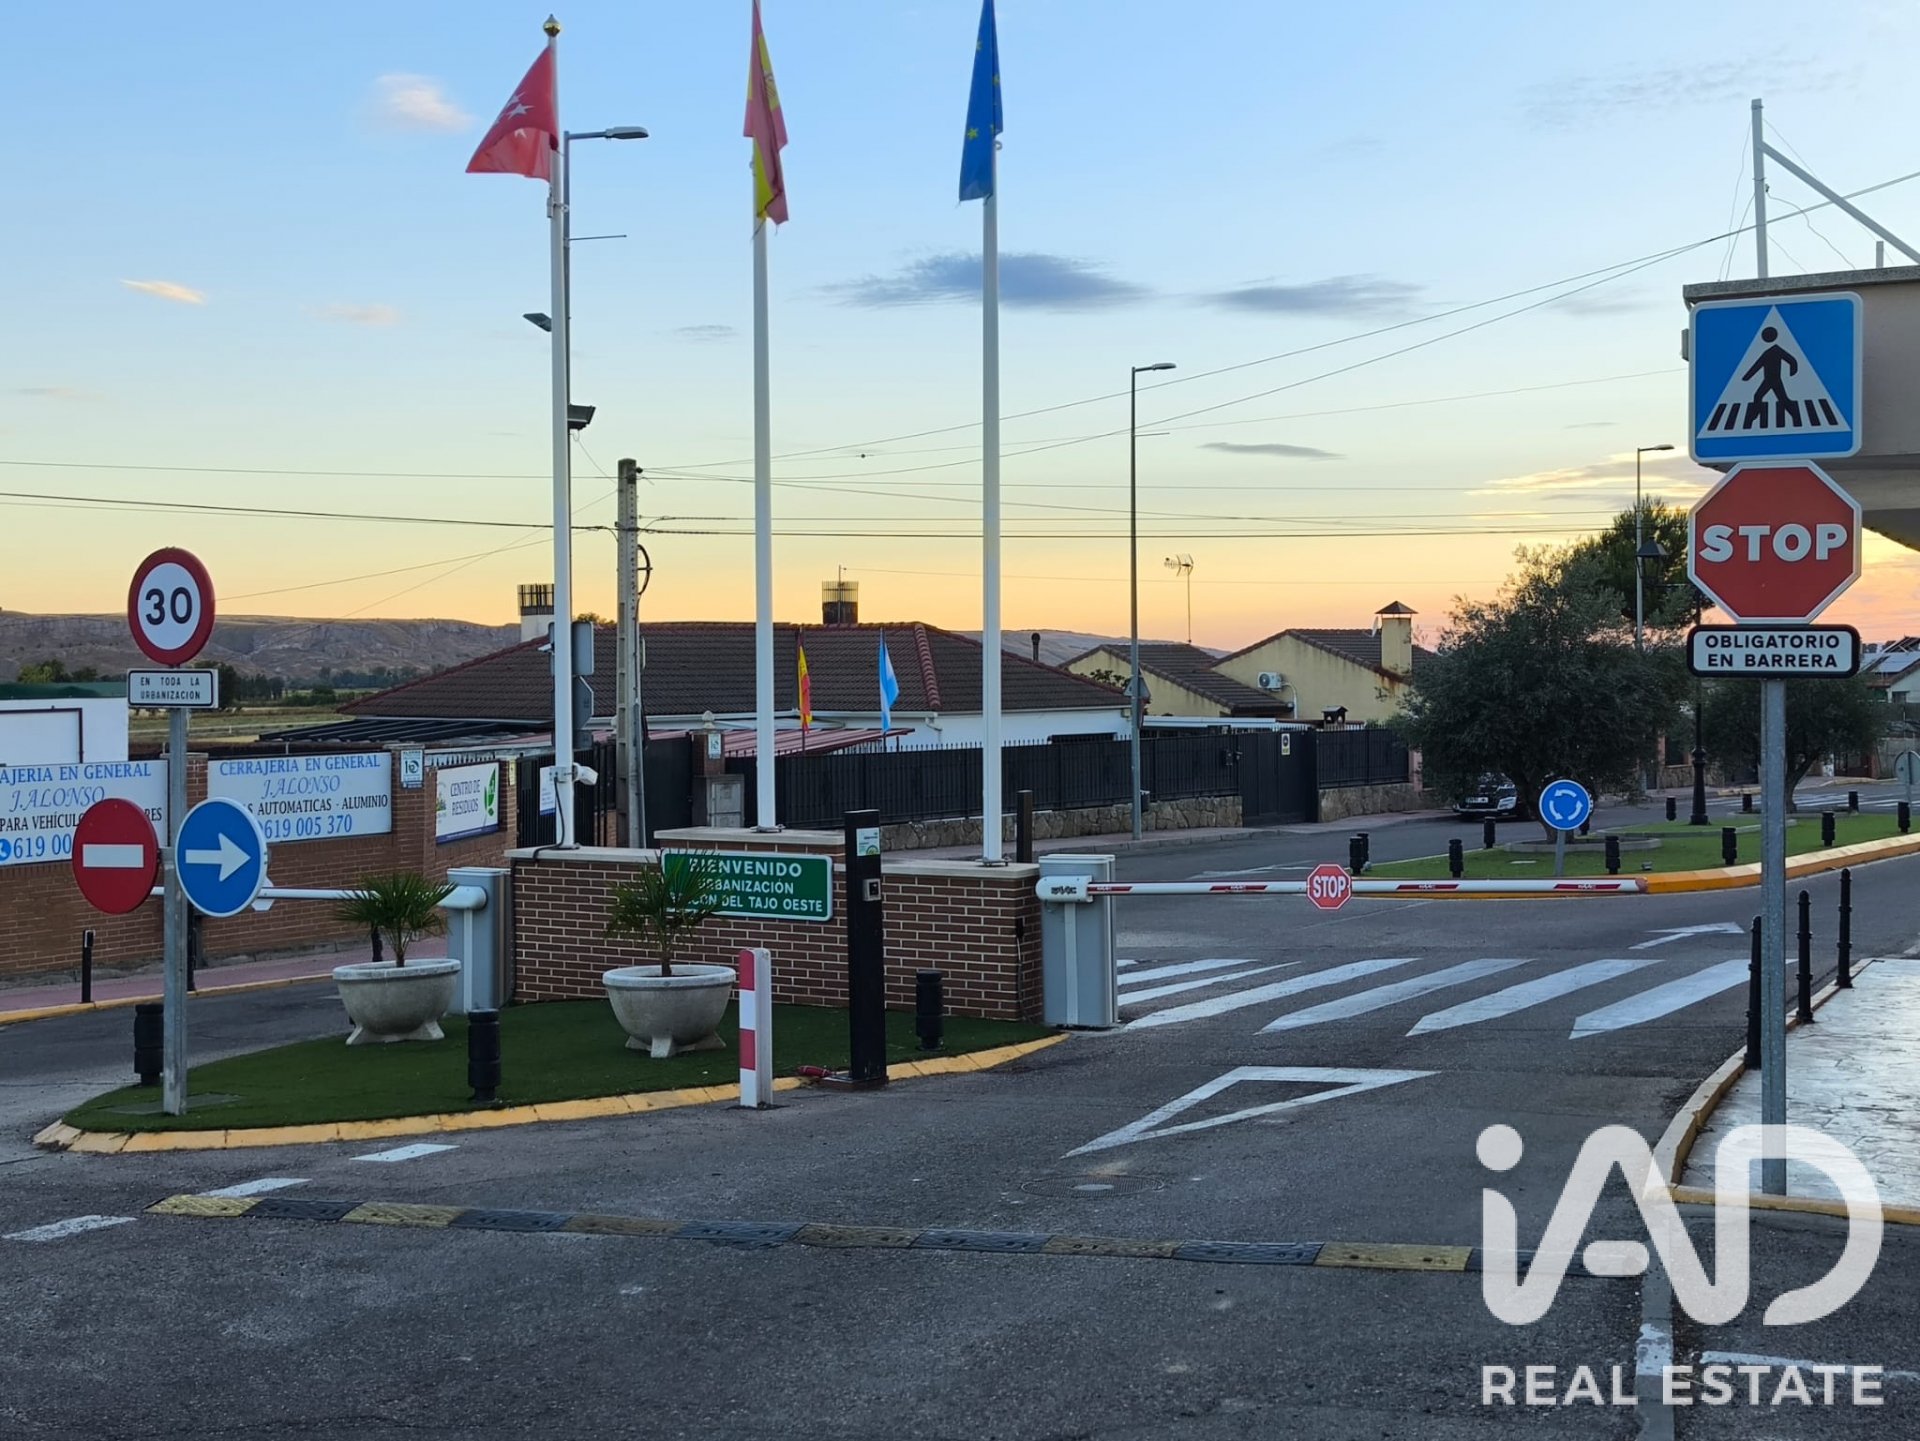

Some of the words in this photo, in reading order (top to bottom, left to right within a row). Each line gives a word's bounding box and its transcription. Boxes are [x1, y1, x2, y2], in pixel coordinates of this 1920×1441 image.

[1699, 523, 1848, 563] STOP
[145, 587, 194, 626] 30
[1705, 634, 1840, 649] OBLIGATORIO
[1708, 654, 1734, 668] EN
[1745, 653, 1838, 668] BARRERA
[140, 677, 150, 686] EN
[160, 677, 181, 686] TODA
[190, 677, 200, 686] LA
[0, 767, 53, 786] AJERIA
[60, 766, 78, 781] EN
[84, 763, 151, 779] GENERAL
[219, 759, 299, 776] CERRAJERIA
[305, 757, 321, 772] EN
[325, 755, 381, 770] GENERAL
[451, 780, 474, 797] CENTRO
[257, 798, 332, 815] AUTOMATICAS
[341, 794, 388, 810] ALUMINIO
[451, 798, 479, 816] RESIDUOS
[0, 816, 28, 832] PARA
[264, 818, 291, 840] 619
[296, 816, 322, 836] 005
[327, 814, 353, 834] 370
[14, 836, 46, 859] 619
[52, 833, 72, 856] 00
[689, 857, 802, 878] BIENVENIDO
[1312, 874, 1346, 899] STOP
[721, 895, 743, 908] DEL
[748, 896, 778, 910] TAJO
[782, 898, 823, 912] OESTE
